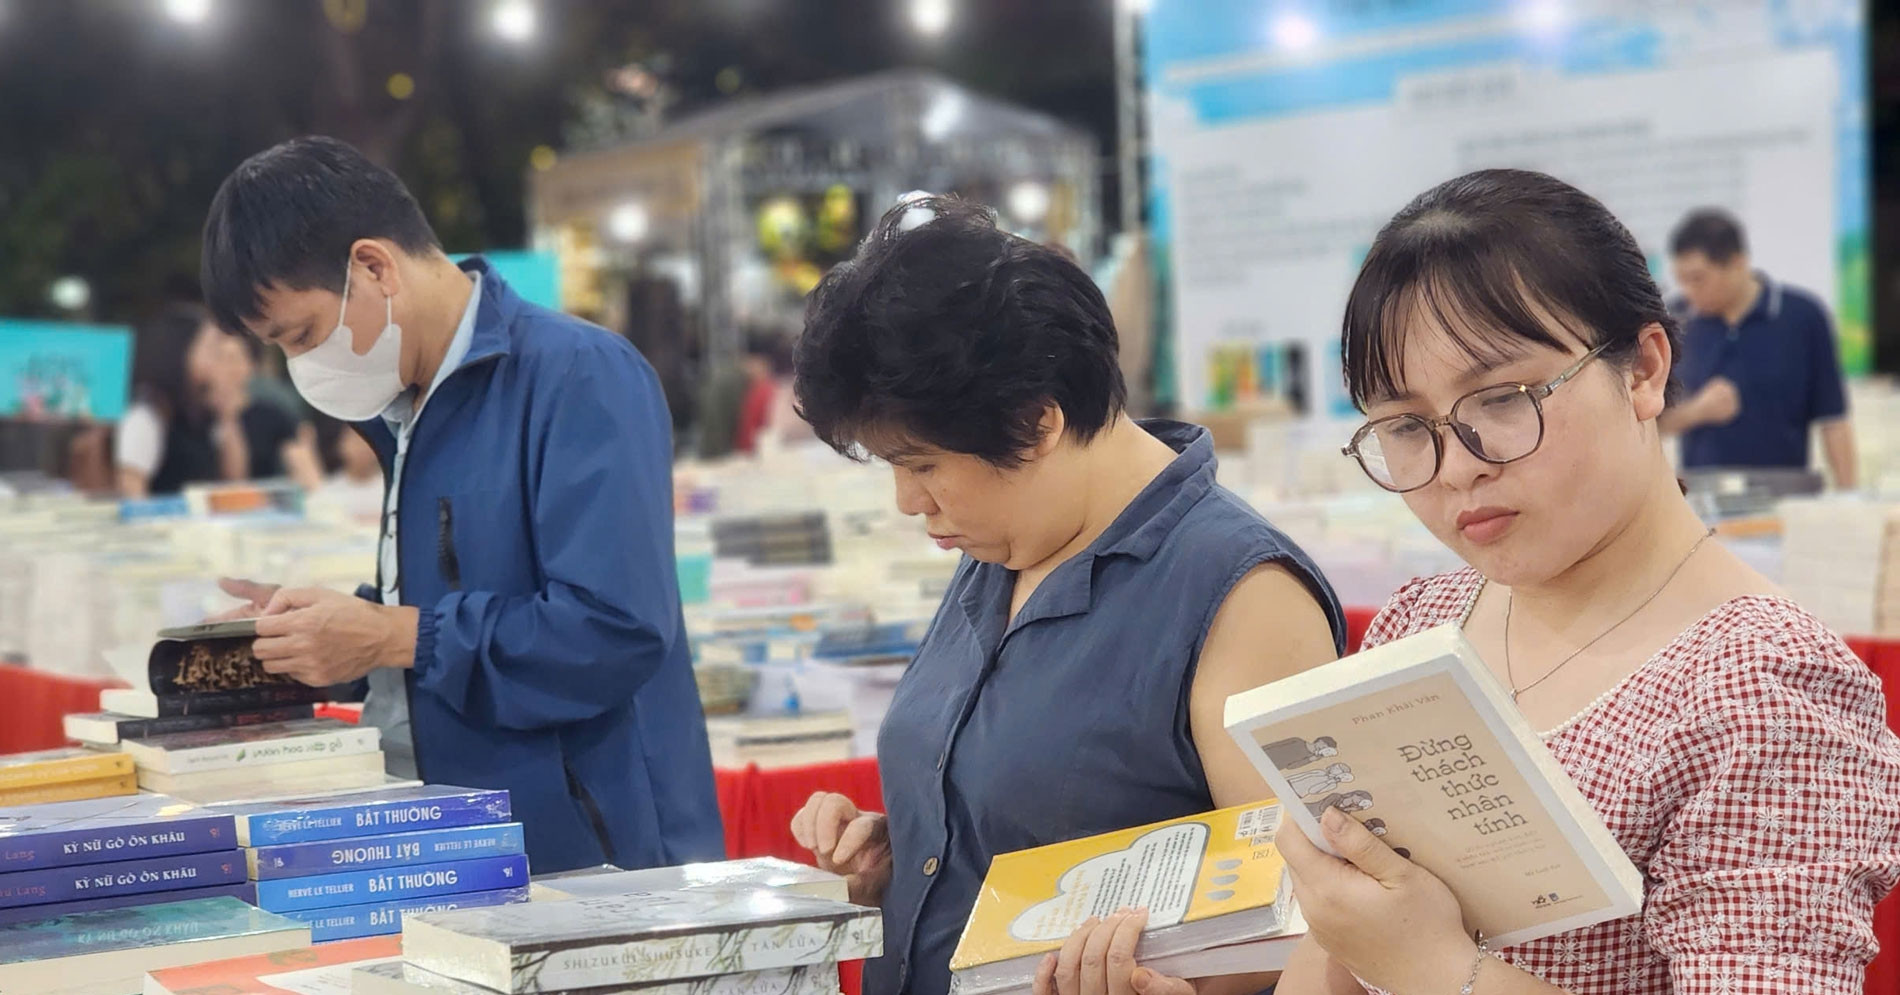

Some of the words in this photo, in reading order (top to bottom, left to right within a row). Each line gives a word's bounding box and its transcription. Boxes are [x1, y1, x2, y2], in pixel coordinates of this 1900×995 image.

[1352, 710, 1385, 725] Phan
[1397, 733, 1473, 763] Đừng
[1411, 752, 1487, 783] thách
[1440, 773, 1500, 798] thức
[356, 808, 380, 827] BẤT
[384, 805, 442, 823] THƯỜNG
[1447, 794, 1515, 820] nhân
[1474, 811, 1529, 836] tính
[313, 886, 324, 896] LE
[325, 883, 355, 895] TELLIER
[368, 873, 393, 893] BẤT
[397, 870, 459, 890] THƯỜNG
[326, 916, 356, 927] TELLIER
[644, 947, 712, 963] SHUSUKE
